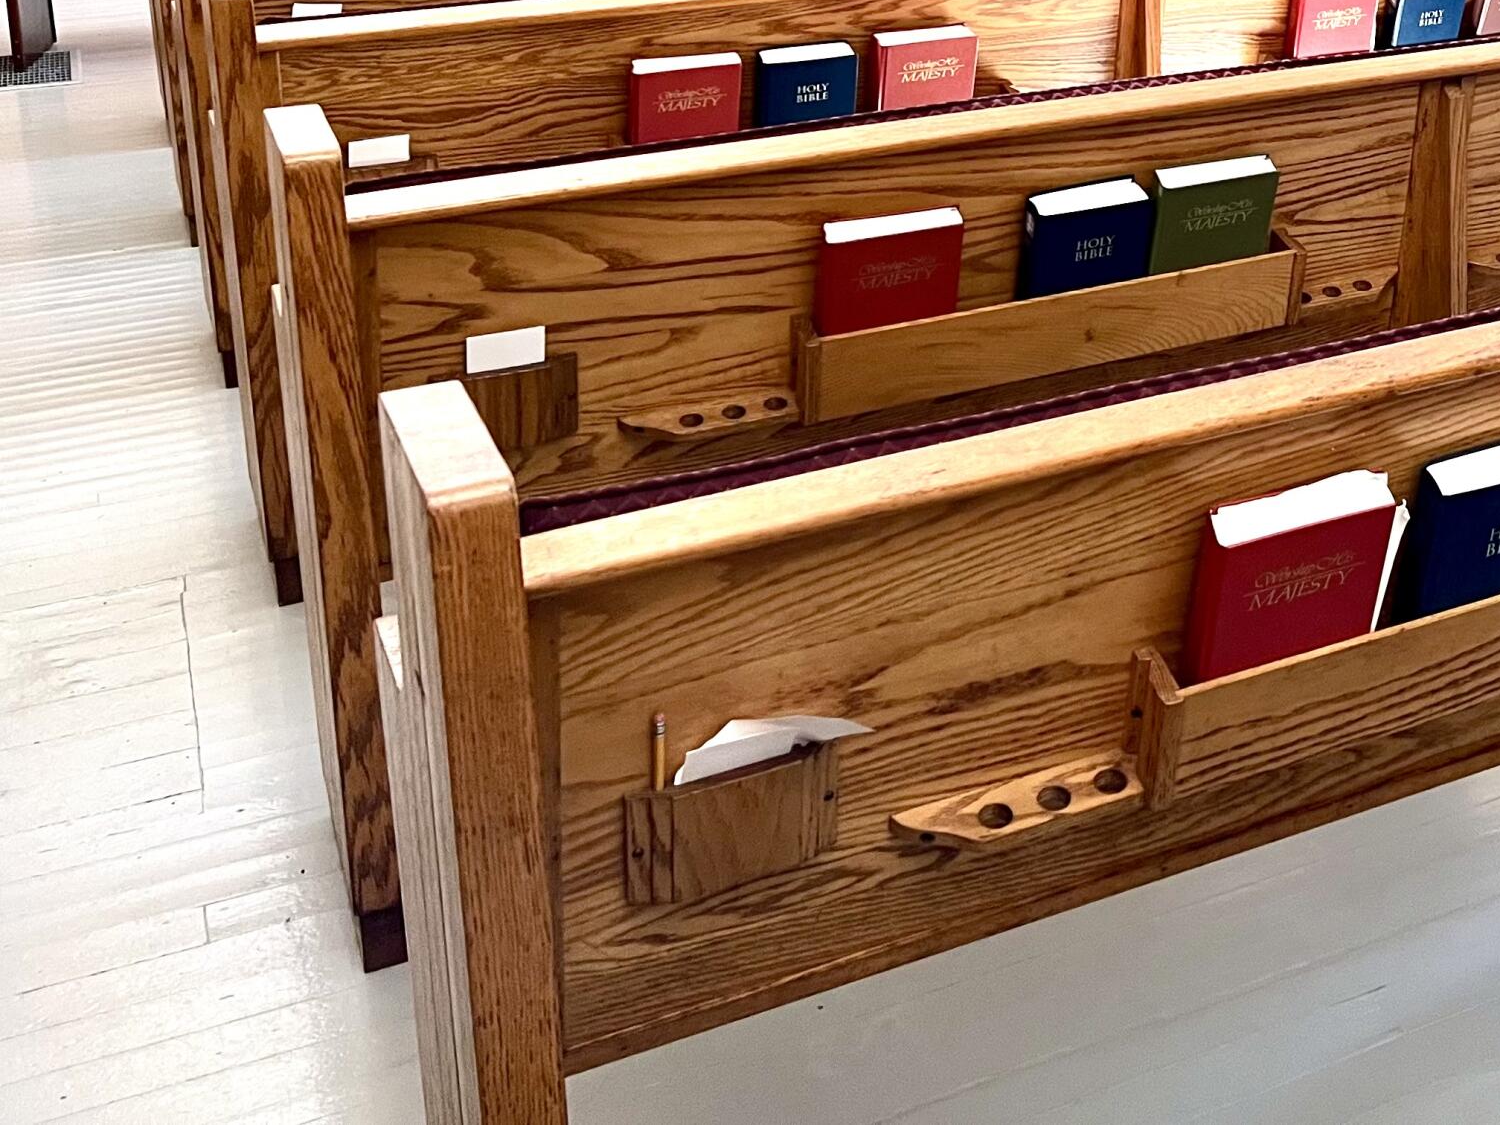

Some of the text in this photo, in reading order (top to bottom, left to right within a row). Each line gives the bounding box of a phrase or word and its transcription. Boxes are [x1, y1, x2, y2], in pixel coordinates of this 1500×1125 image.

[1420, 9, 1445, 19] HOLY
[901, 66, 959, 83] MAJESTY
[797, 83, 830, 94] HOLY
[658, 97, 721, 113] MAJESTY
[796, 91, 829, 104] BIBLE
[1184, 210, 1253, 233] MAJESTY
[1076, 235, 1116, 250] HOLY
[1075, 246, 1113, 262] BIBLE
[1248, 567, 1354, 612] MAJESTY
